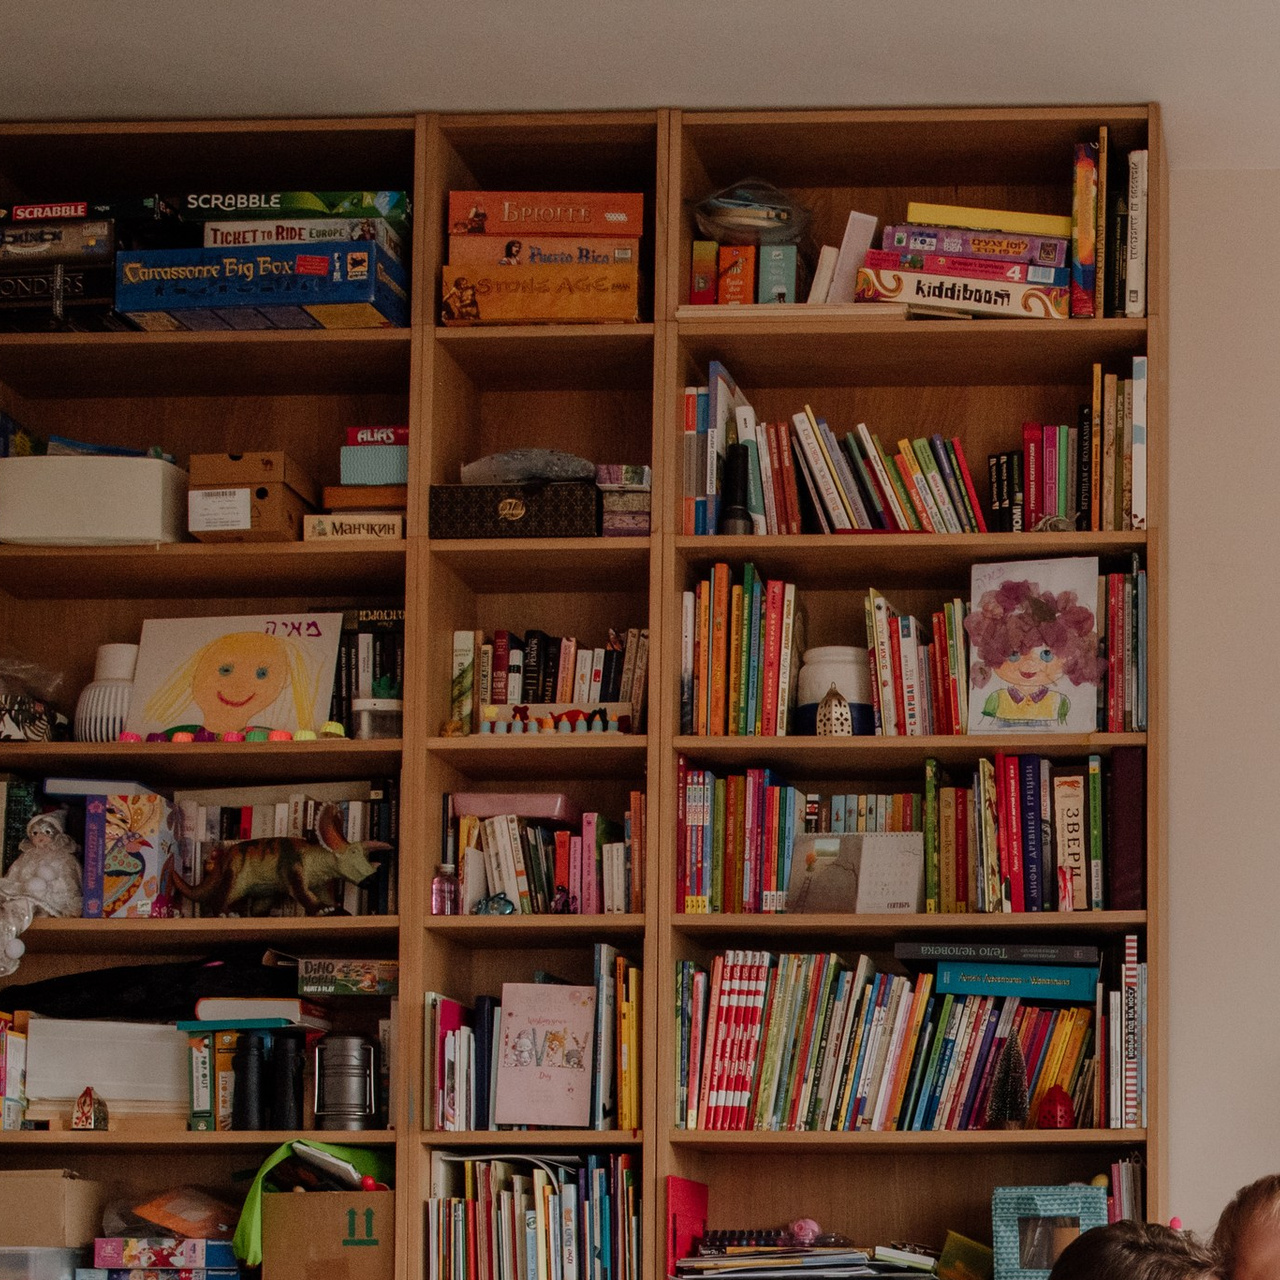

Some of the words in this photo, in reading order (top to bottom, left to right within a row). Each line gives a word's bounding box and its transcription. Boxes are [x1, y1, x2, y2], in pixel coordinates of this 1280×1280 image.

[16, 205, 85, 218] SCRABBLE
[187, 194, 281, 211] SCRABBLE
[211, 228, 258, 246] TICKET
[275, 225, 306, 241] RIDE
[309, 228, 345, 238] EUROPE
[529, 245, 573, 264] Puerto
[577, 246, 609, 264] Rico
[223, 257, 254, 281] Big
[257, 256, 293, 276] Box
[1006, 265, 1022, 281] 4
[0, 276, 84, 296] ONDRS
[476, 277, 550, 295] STONE
[556, 275, 609, 295] AGE
[915, 279, 1011, 307] kiddiboom
[357, 428, 395, 444] ALIAS
[331, 521, 396, 537] Манчкин
[264, 620, 322, 638] מאיה
[907, 684, 915, 719] МАРШАК
[1026, 765, 1036, 806] ГРЕЦИИ
[1026, 812, 1037, 859] ДРЕВНЕЙ
[1066, 808, 1082, 878] ЗВЕРИ
[1029, 864, 1038, 898] МИФЫ
[920, 946, 975, 956] человека
[979, 947, 1008, 959] Тело
[1128, 987, 1136, 1007] НОСУ
[1128, 1008, 1136, 1019] НА
[1127, 1020, 1136, 1033] ГОД
[1127, 1033, 1136, 1060] НОВЫЙ
